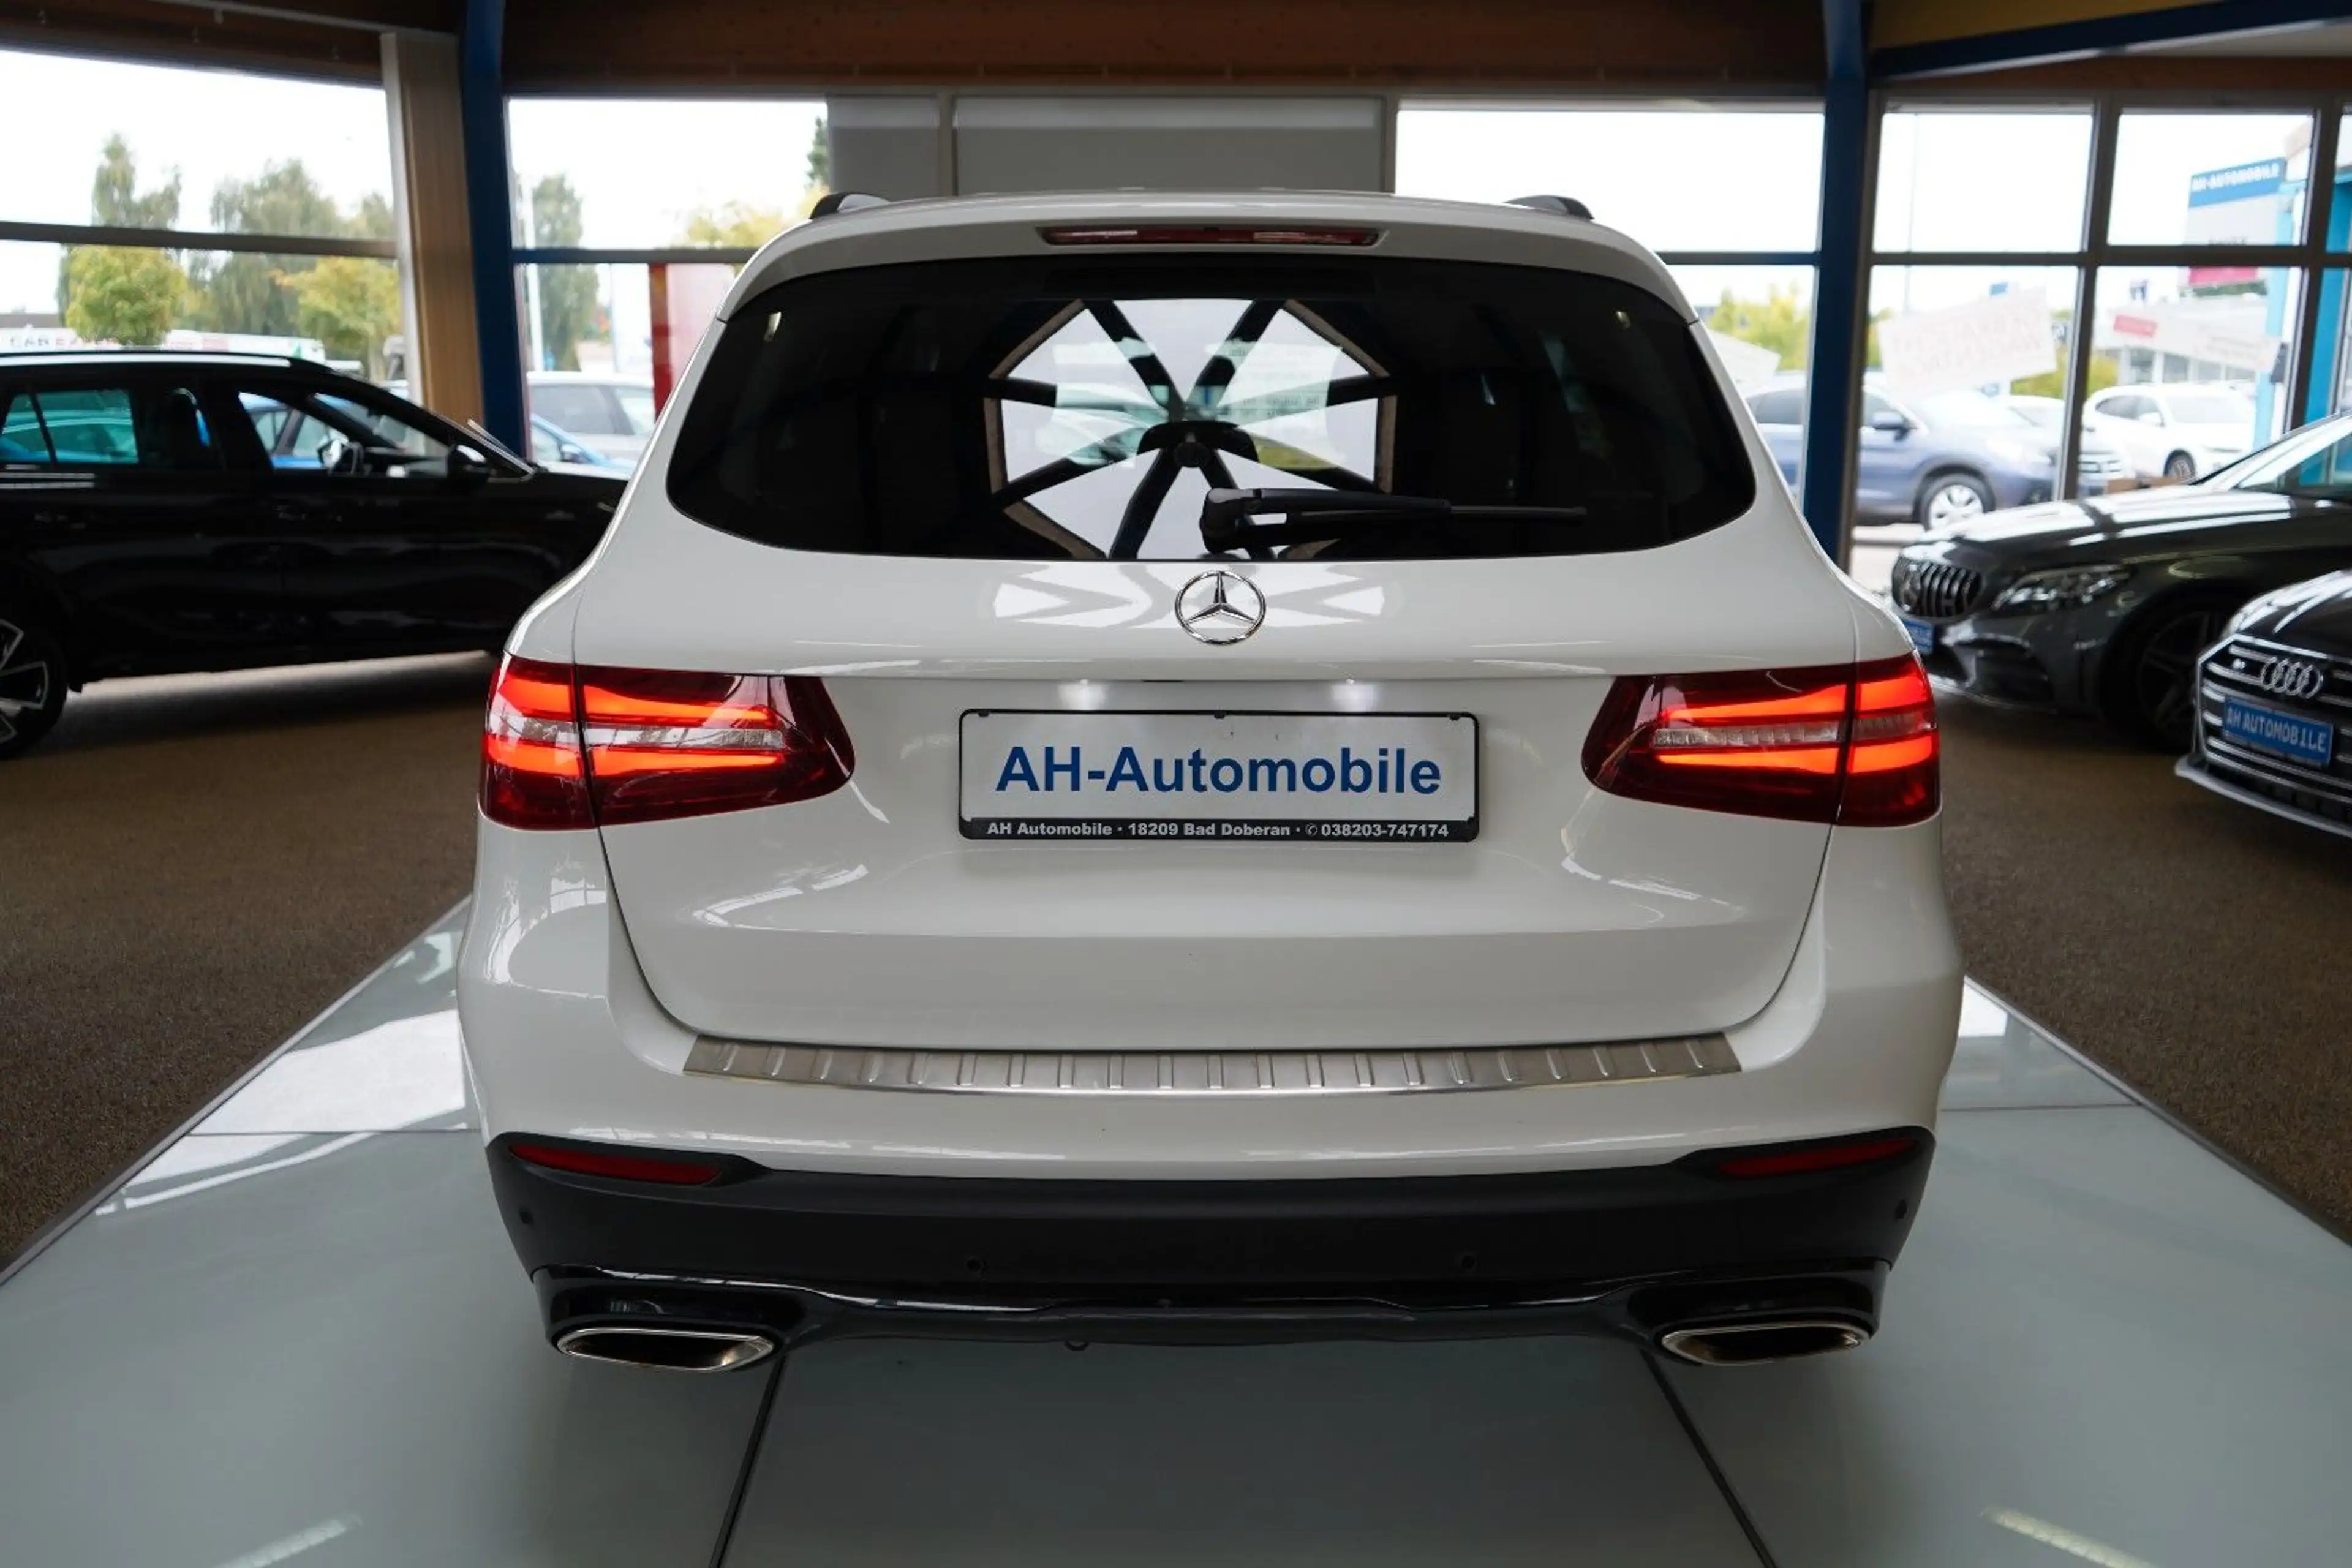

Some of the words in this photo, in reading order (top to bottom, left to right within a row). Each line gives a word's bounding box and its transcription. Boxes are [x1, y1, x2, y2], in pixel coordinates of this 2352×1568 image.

[2226, 706, 2242, 728] AH
[2242, 712, 2327, 753] AUTOMOBILE
[996, 746, 1441, 794] AH-Automobile
[987, 823, 1011, 834] AH
[1017, 823, 1112, 835] Automobile
[1128, 823, 1178, 835] 18209
[1183, 823, 1215, 835] Bad
[1221, 824, 1290, 835] Doberan
[1321, 824, 1449, 837] 038203-747174
